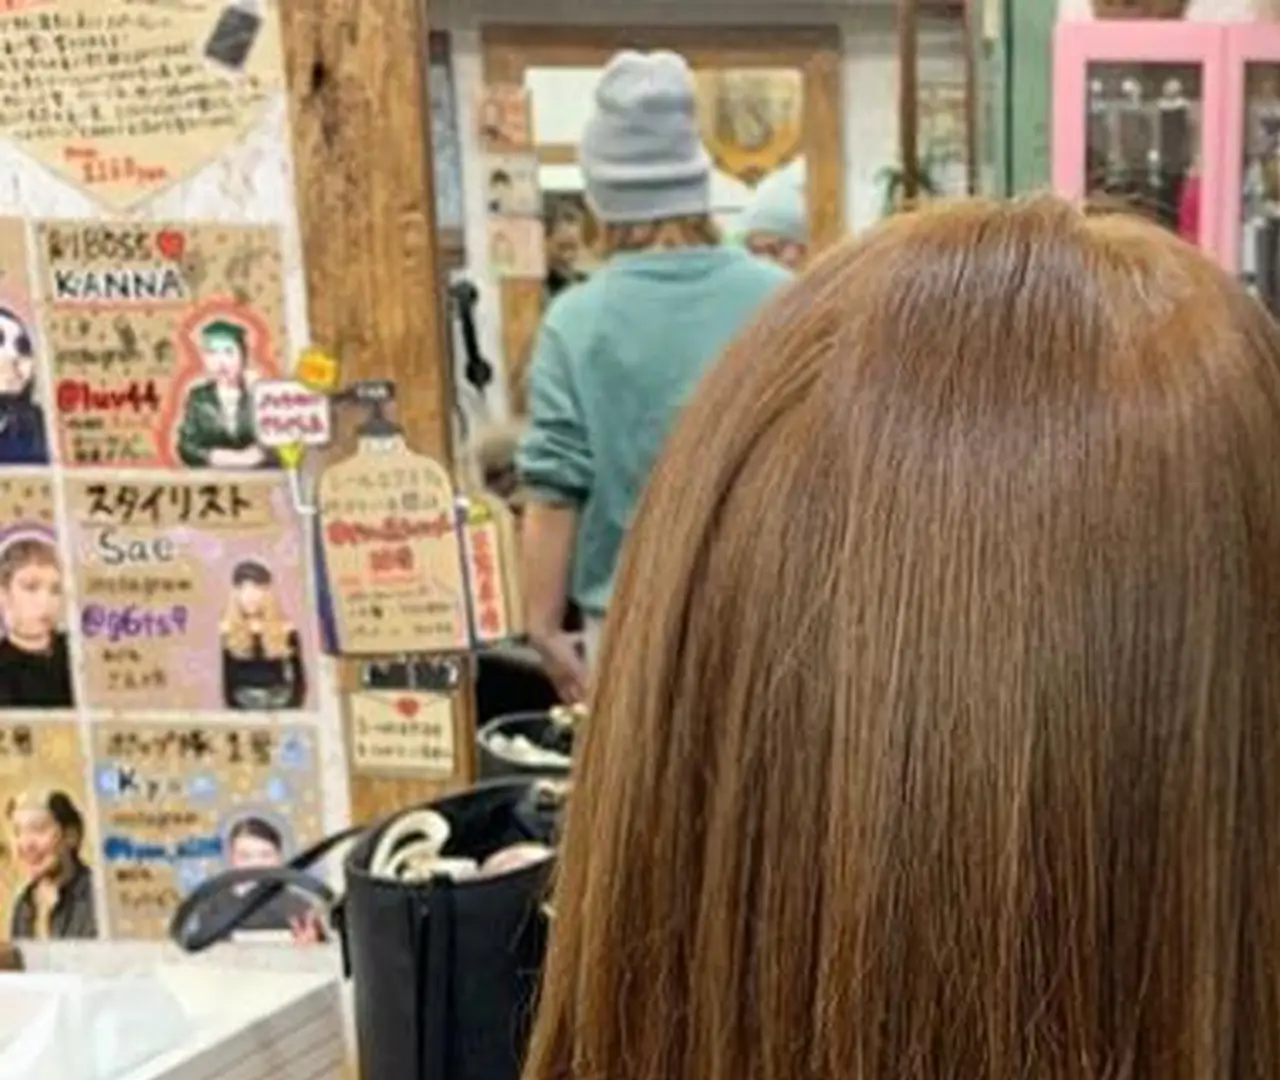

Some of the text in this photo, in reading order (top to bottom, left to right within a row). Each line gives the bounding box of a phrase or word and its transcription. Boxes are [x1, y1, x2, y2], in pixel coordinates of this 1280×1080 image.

[56, 269, 183, 298] KANNA
[86, 485, 251, 525] スタイリスト
